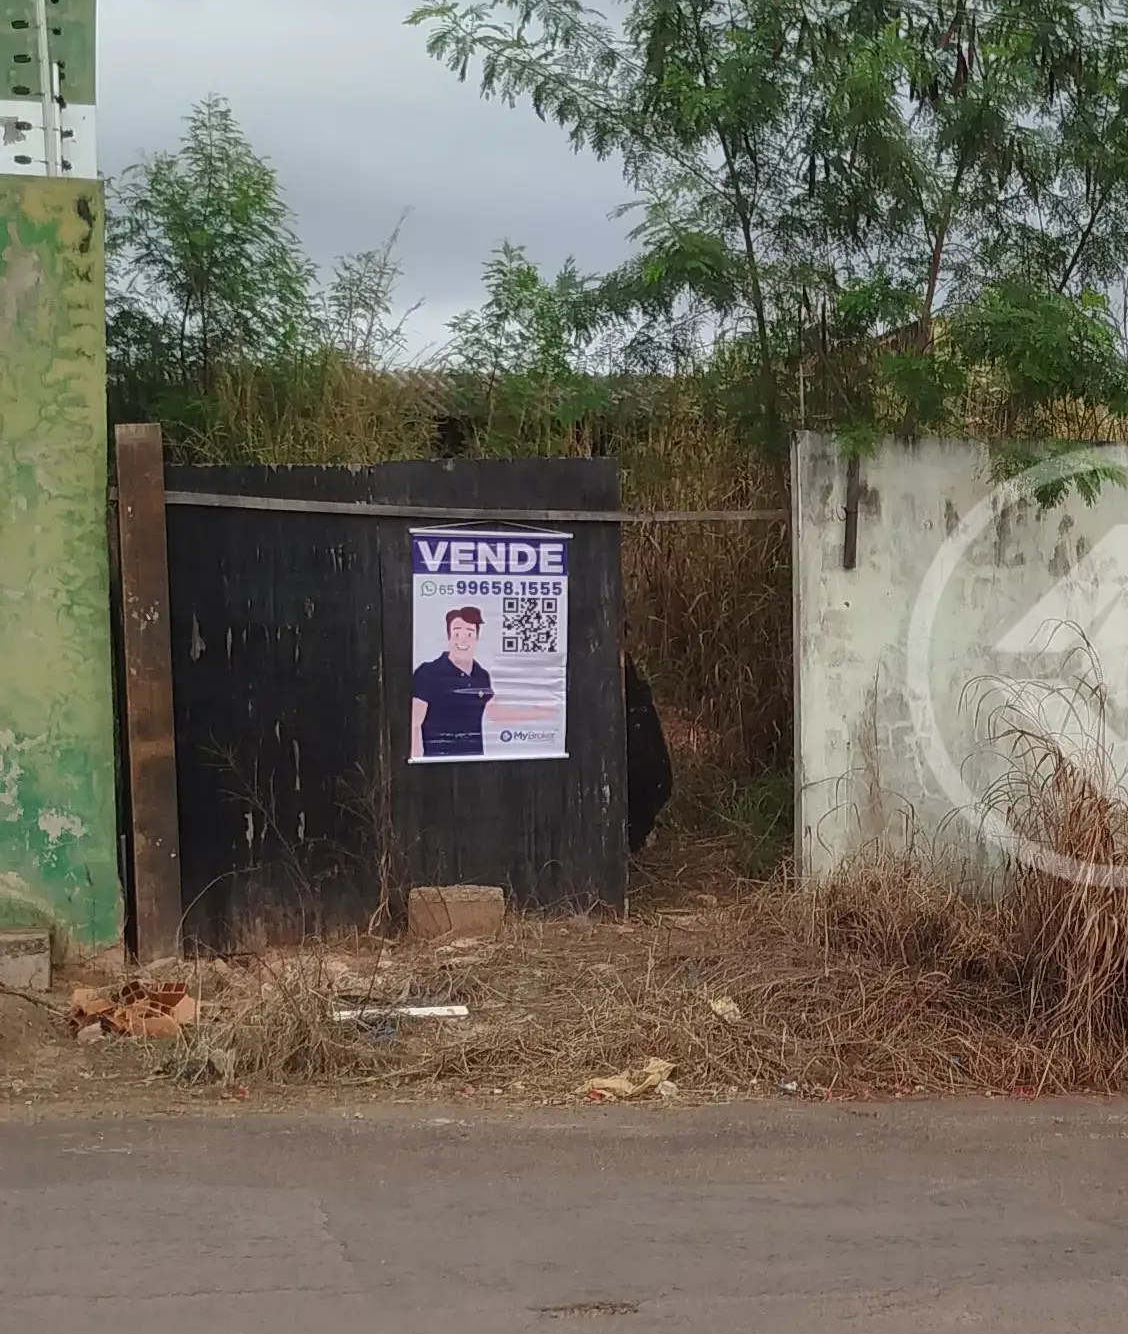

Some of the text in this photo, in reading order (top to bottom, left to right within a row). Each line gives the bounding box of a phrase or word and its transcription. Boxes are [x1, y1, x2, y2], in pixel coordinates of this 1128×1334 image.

[417, 540, 564, 573] VENDE
[439, 580, 563, 596] 65 99658.1555
[513, 731, 556, 742] MyBroker
